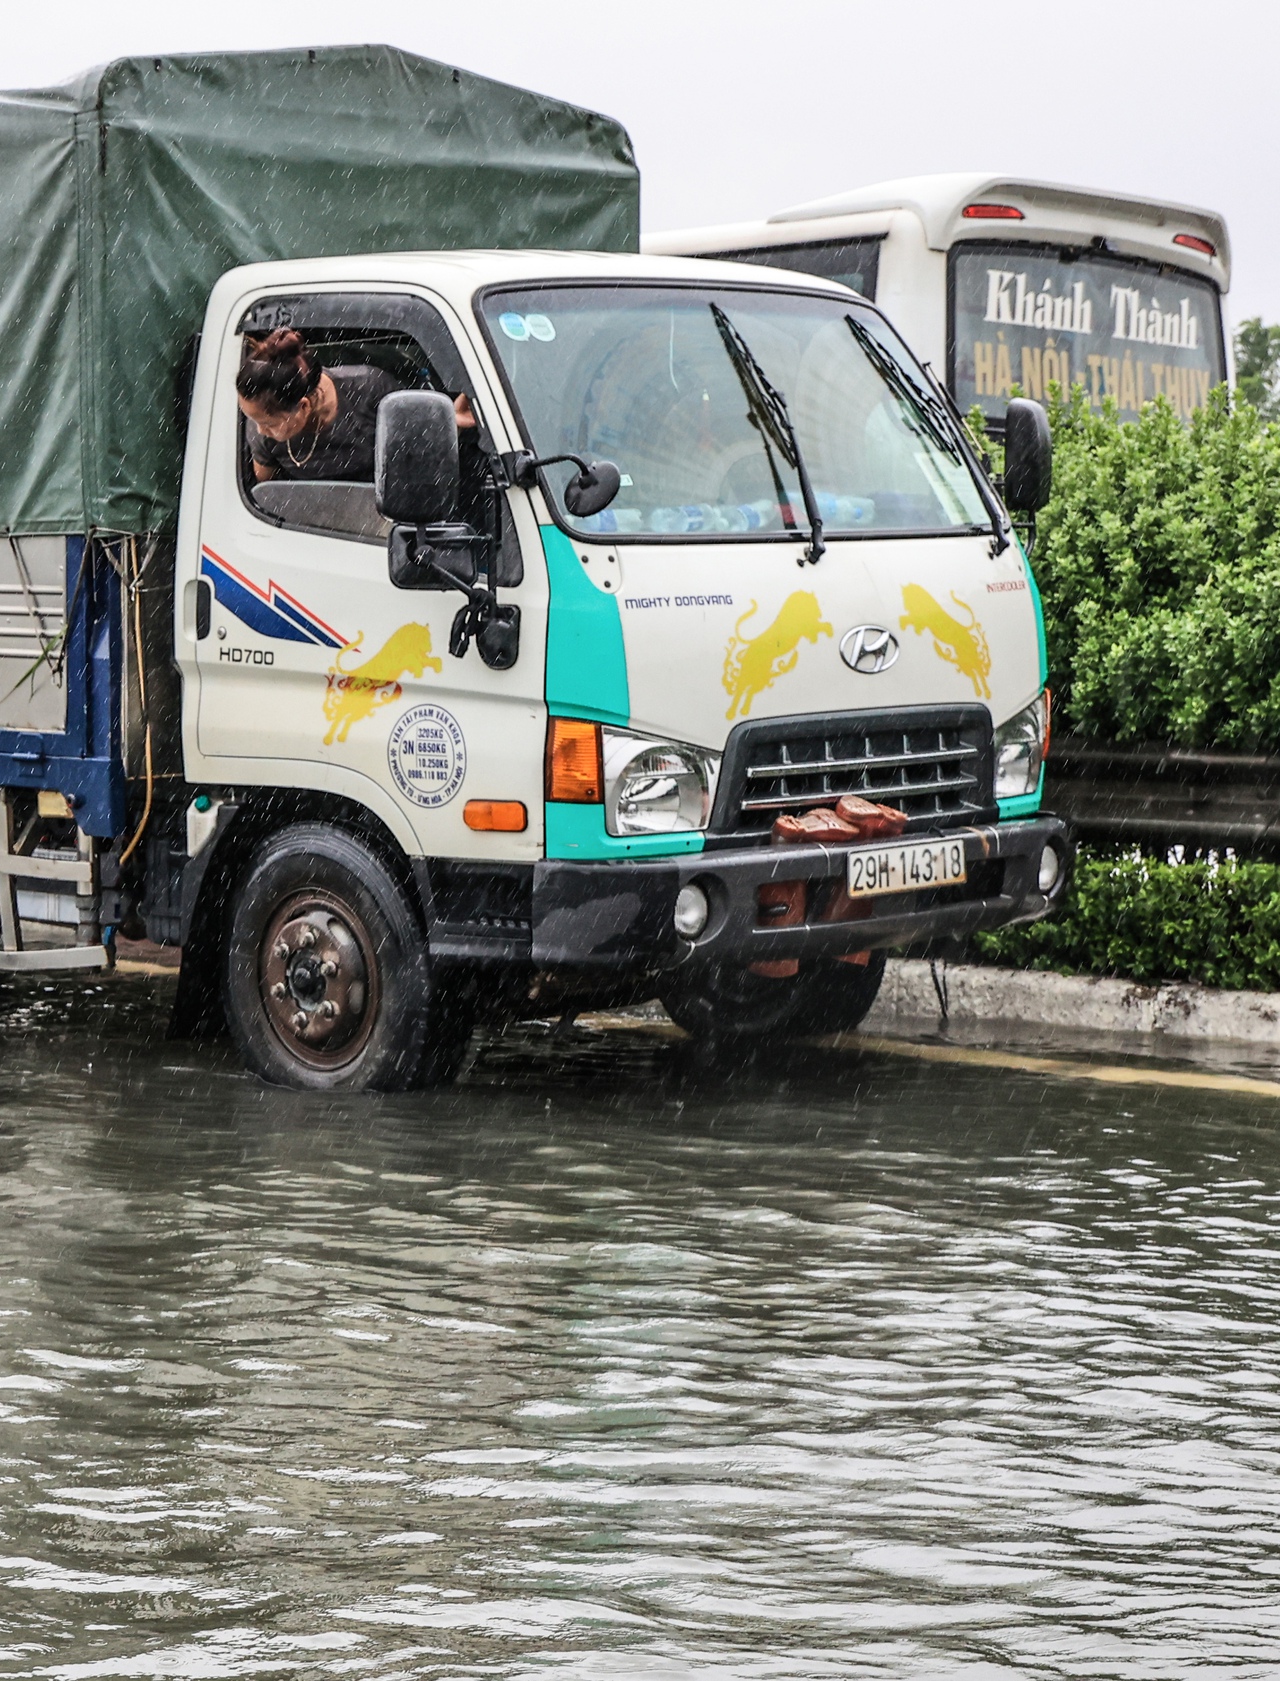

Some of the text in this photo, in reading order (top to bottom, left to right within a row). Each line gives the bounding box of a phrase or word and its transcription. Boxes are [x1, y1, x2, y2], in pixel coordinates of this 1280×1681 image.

[983, 269, 1198, 350] Khánh Thành
[974, 331, 1013, 398] HÀ
[624, 594, 733, 610] MIGHTY DONGVANG
[219, 647, 275, 666] HD700
[402, 739, 415, 755] 3N
